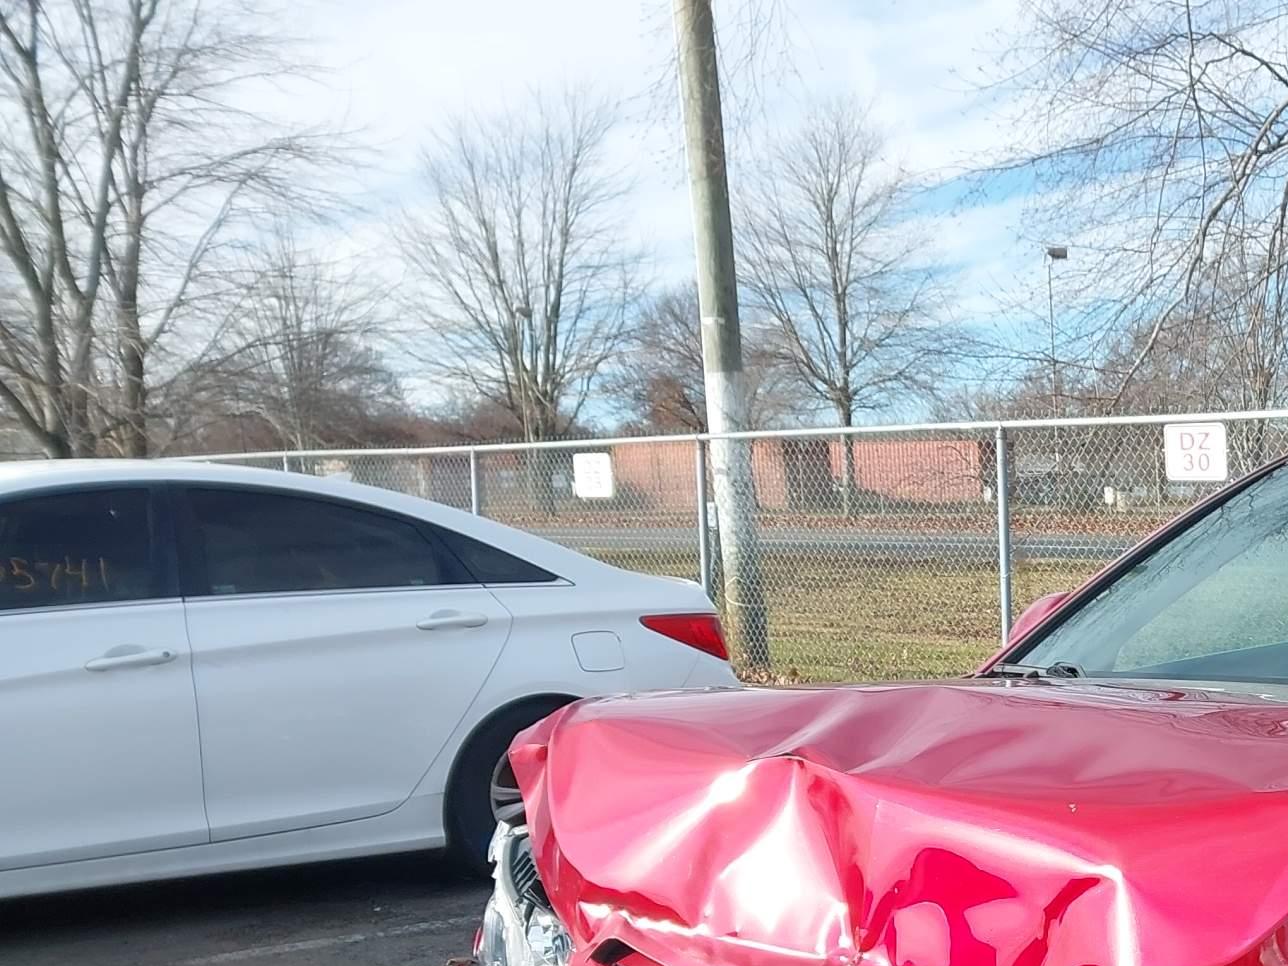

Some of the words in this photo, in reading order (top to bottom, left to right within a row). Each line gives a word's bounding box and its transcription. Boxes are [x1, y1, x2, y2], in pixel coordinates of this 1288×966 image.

[1180, 432, 1211, 450] DZ
[1183, 453, 1210, 472] 30
[0, 555, 110, 592] 5741
